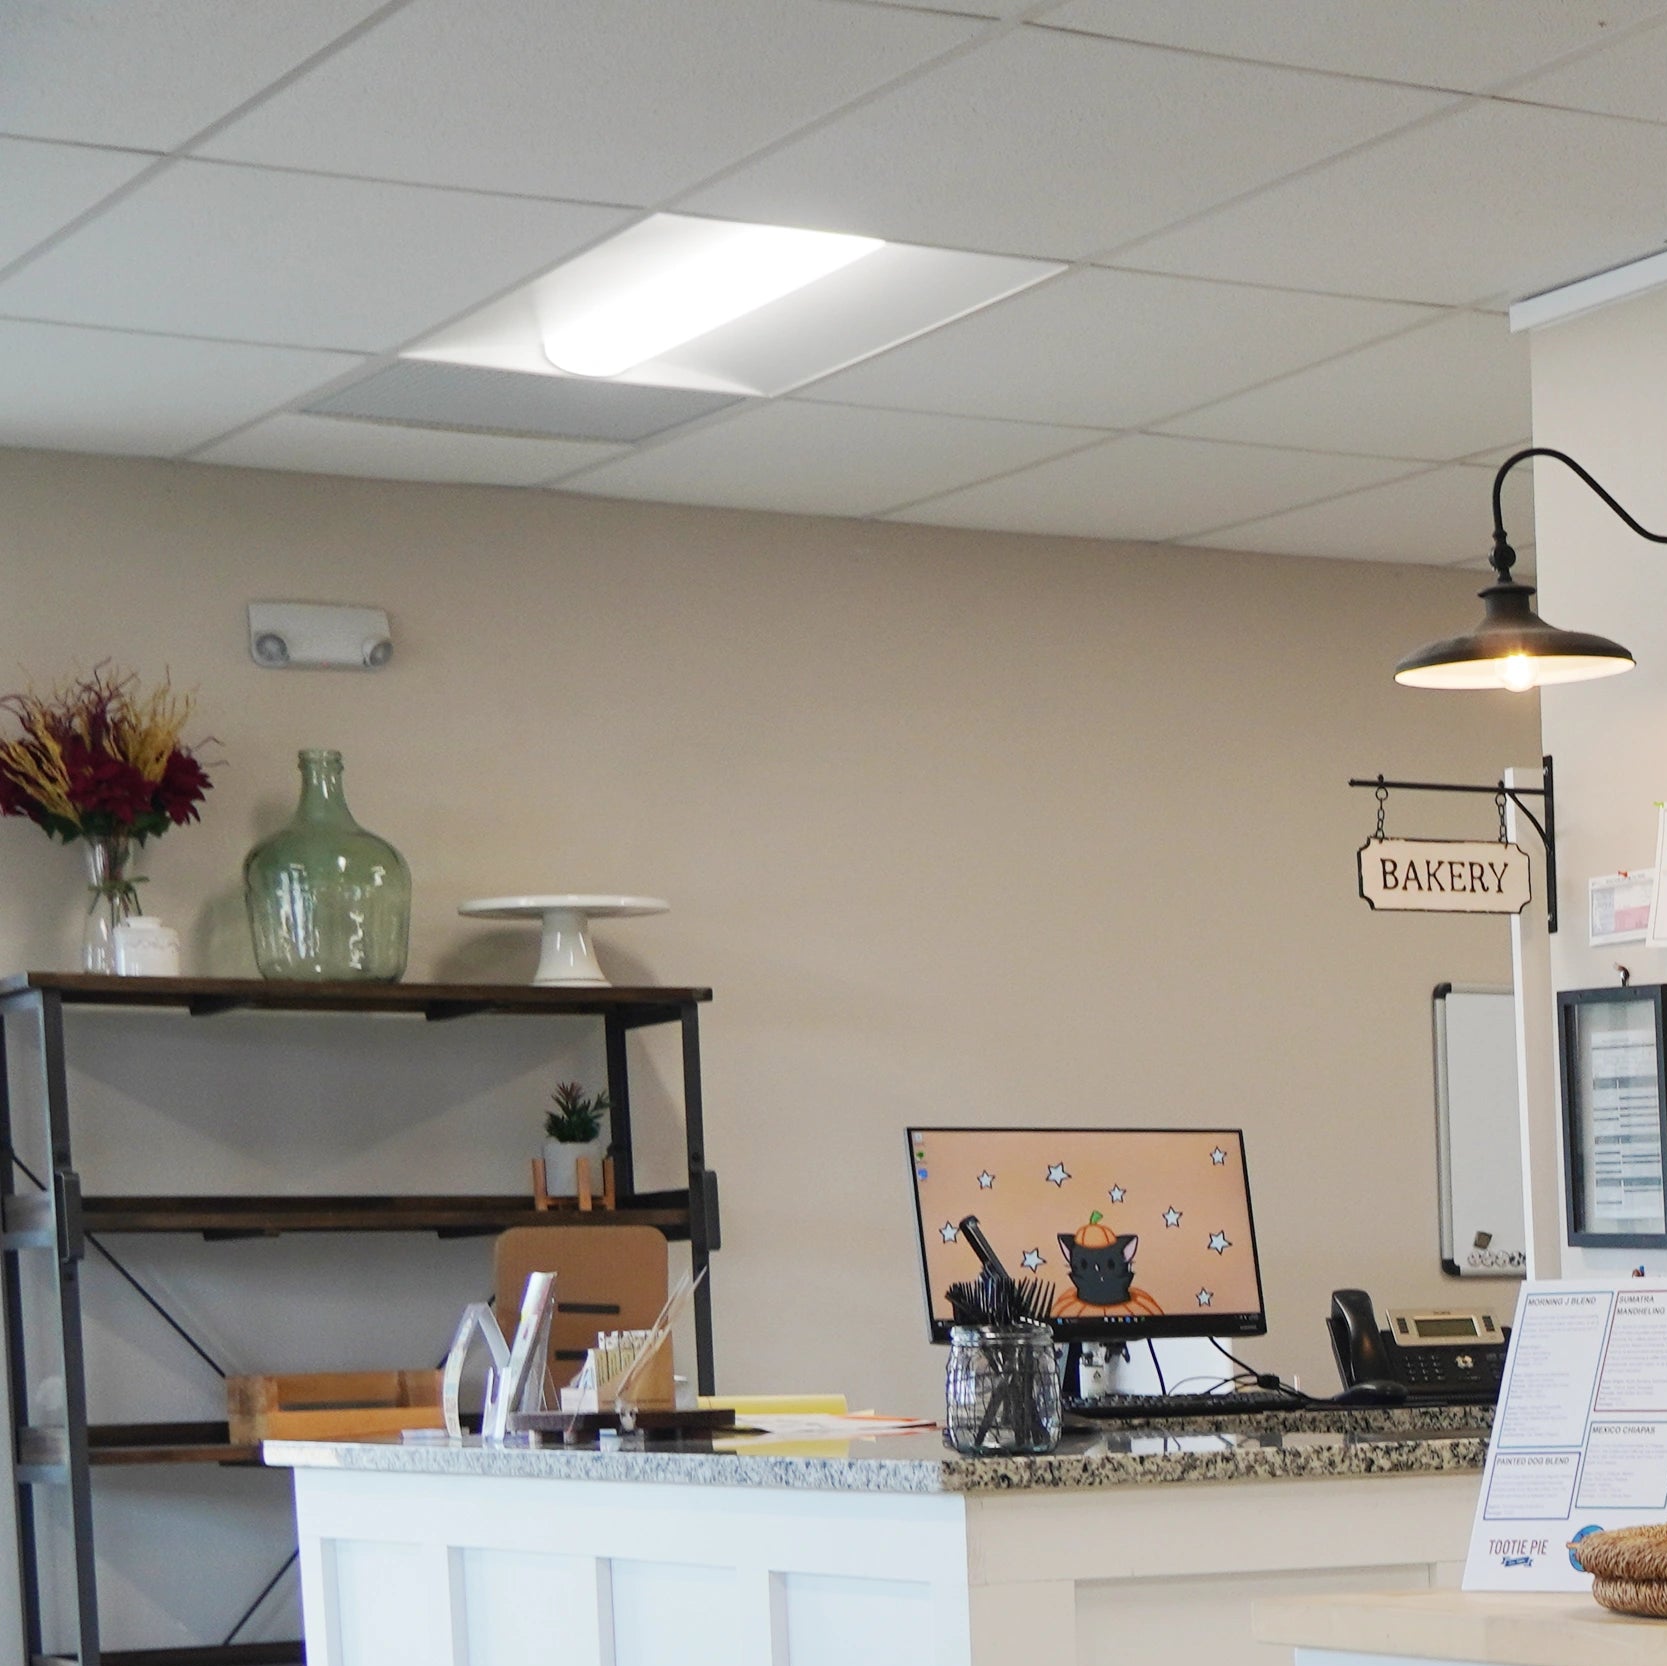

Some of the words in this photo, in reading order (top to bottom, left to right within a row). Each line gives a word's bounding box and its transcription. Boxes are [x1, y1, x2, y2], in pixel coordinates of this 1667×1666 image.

[1380, 857, 1508, 894] BAKERY
[1527, 1298, 1563, 1306] MORNING
[1570, 1297, 1596, 1305] BLEND
[1619, 1296, 1654, 1304] SUMATRA
[1592, 1426, 1620, 1434] MEXICO
[1496, 1457, 1526, 1465] PAINTED
[1527, 1457, 1544, 1465] DOG
[1489, 1539, 1529, 1555] TOOTIE
[1530, 1539, 1549, 1555] PIE
